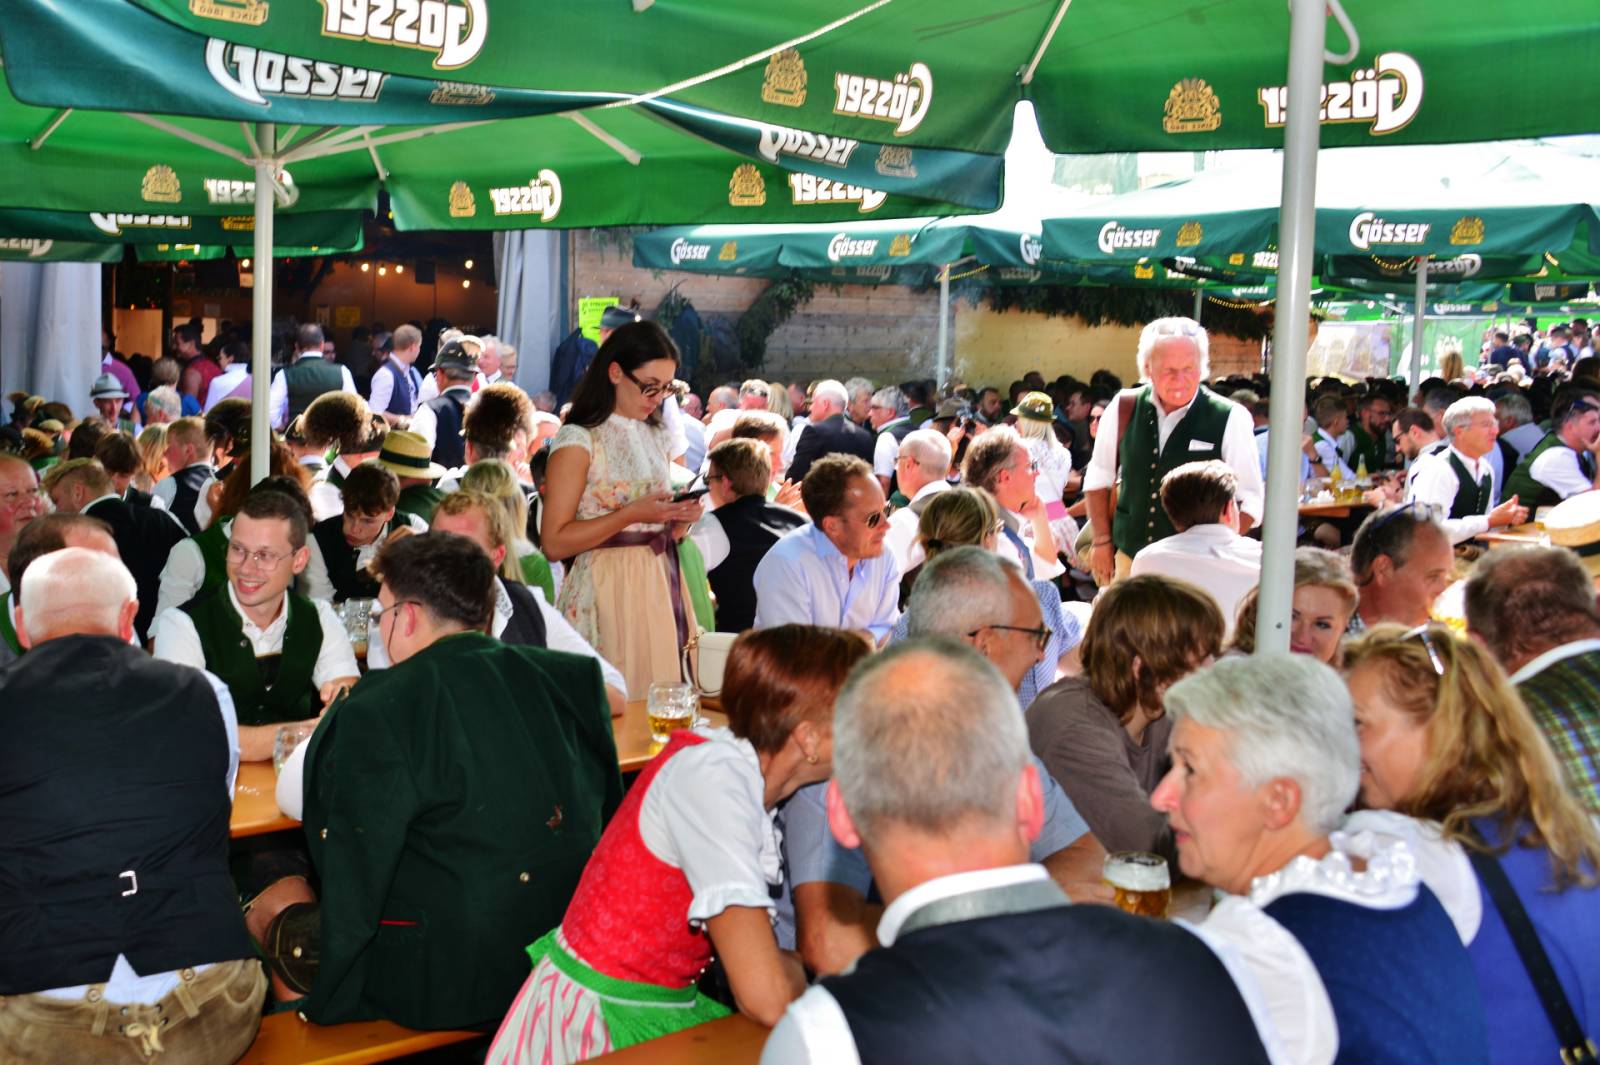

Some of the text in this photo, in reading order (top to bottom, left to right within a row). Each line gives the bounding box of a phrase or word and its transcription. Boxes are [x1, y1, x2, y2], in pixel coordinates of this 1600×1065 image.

[828, 232, 878, 262] Gösser
[1098, 221, 1161, 253] Gösser
[1350, 212, 1431, 251] Gösser
[671, 237, 711, 265] Gösser
